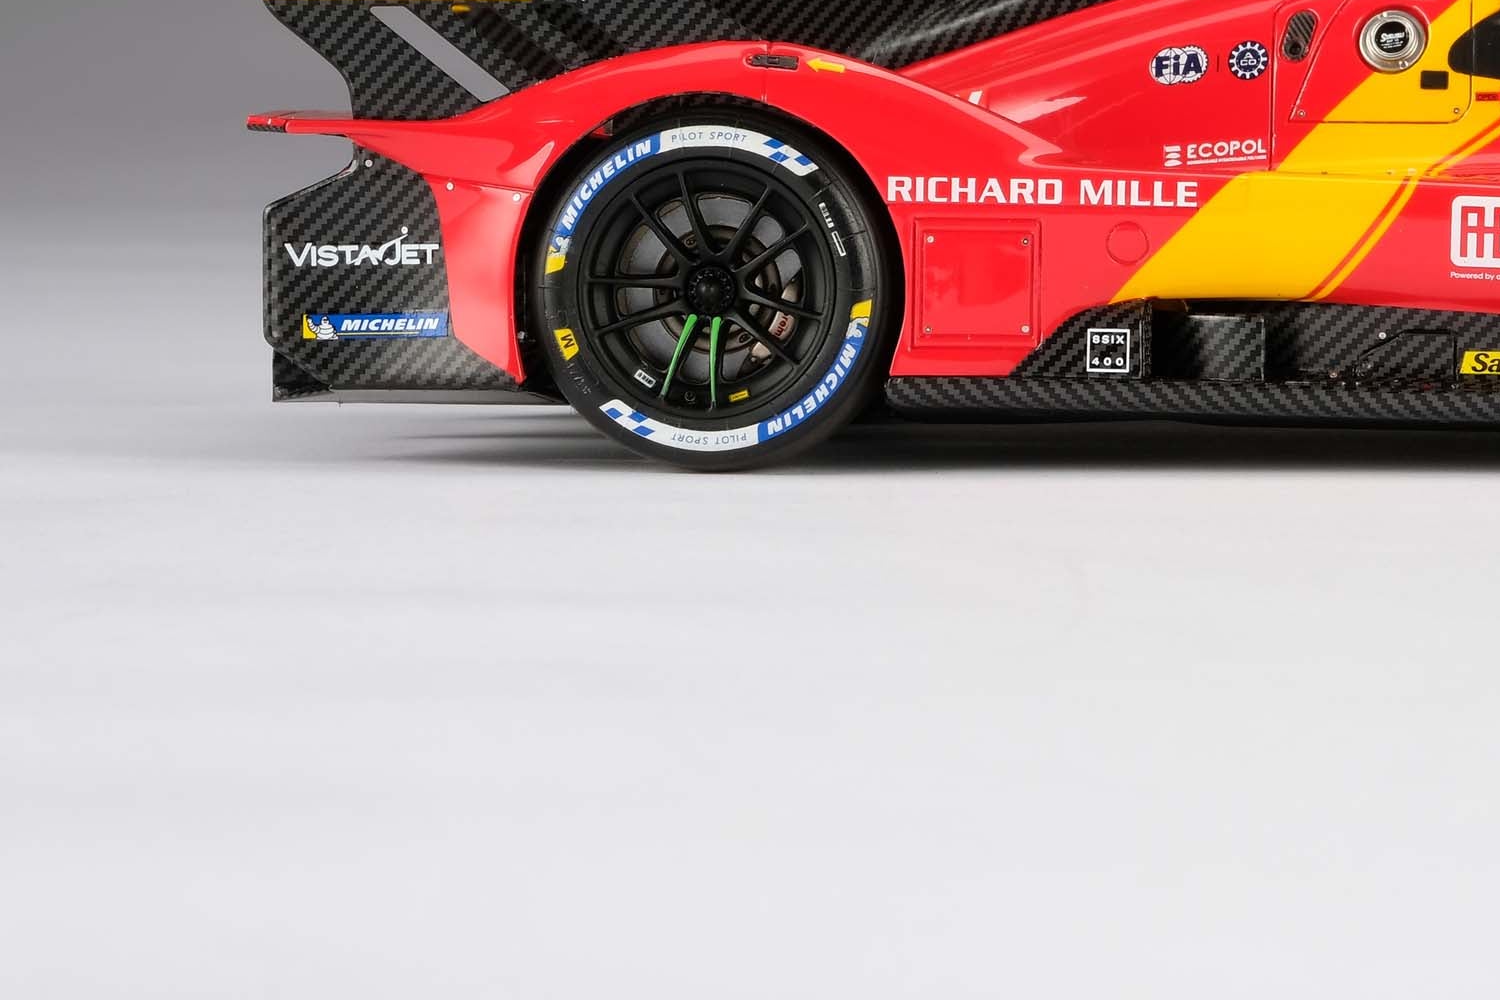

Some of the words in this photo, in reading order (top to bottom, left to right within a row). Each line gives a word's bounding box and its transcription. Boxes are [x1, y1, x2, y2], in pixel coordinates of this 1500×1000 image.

[671, 132, 703, 144] PILOT
[710, 131, 748, 143] SPORT
[1187, 138, 1267, 159] ECOPOL
[561, 140, 651, 231] MICHELIN
[887, 176, 1063, 205] RICHARD
[1079, 180, 1199, 208] MILLE
[1450, 271, 1484, 280] Powered
[1485, 272, 1495, 281] by
[341, 317, 439, 331] MICHELIN
[560, 334, 575, 349] M
[1091, 356, 1125, 367] 400
[767, 343, 857, 437] MICHELIN
[671, 433, 709, 446] SPORT
[714, 433, 748, 445] PILOT
